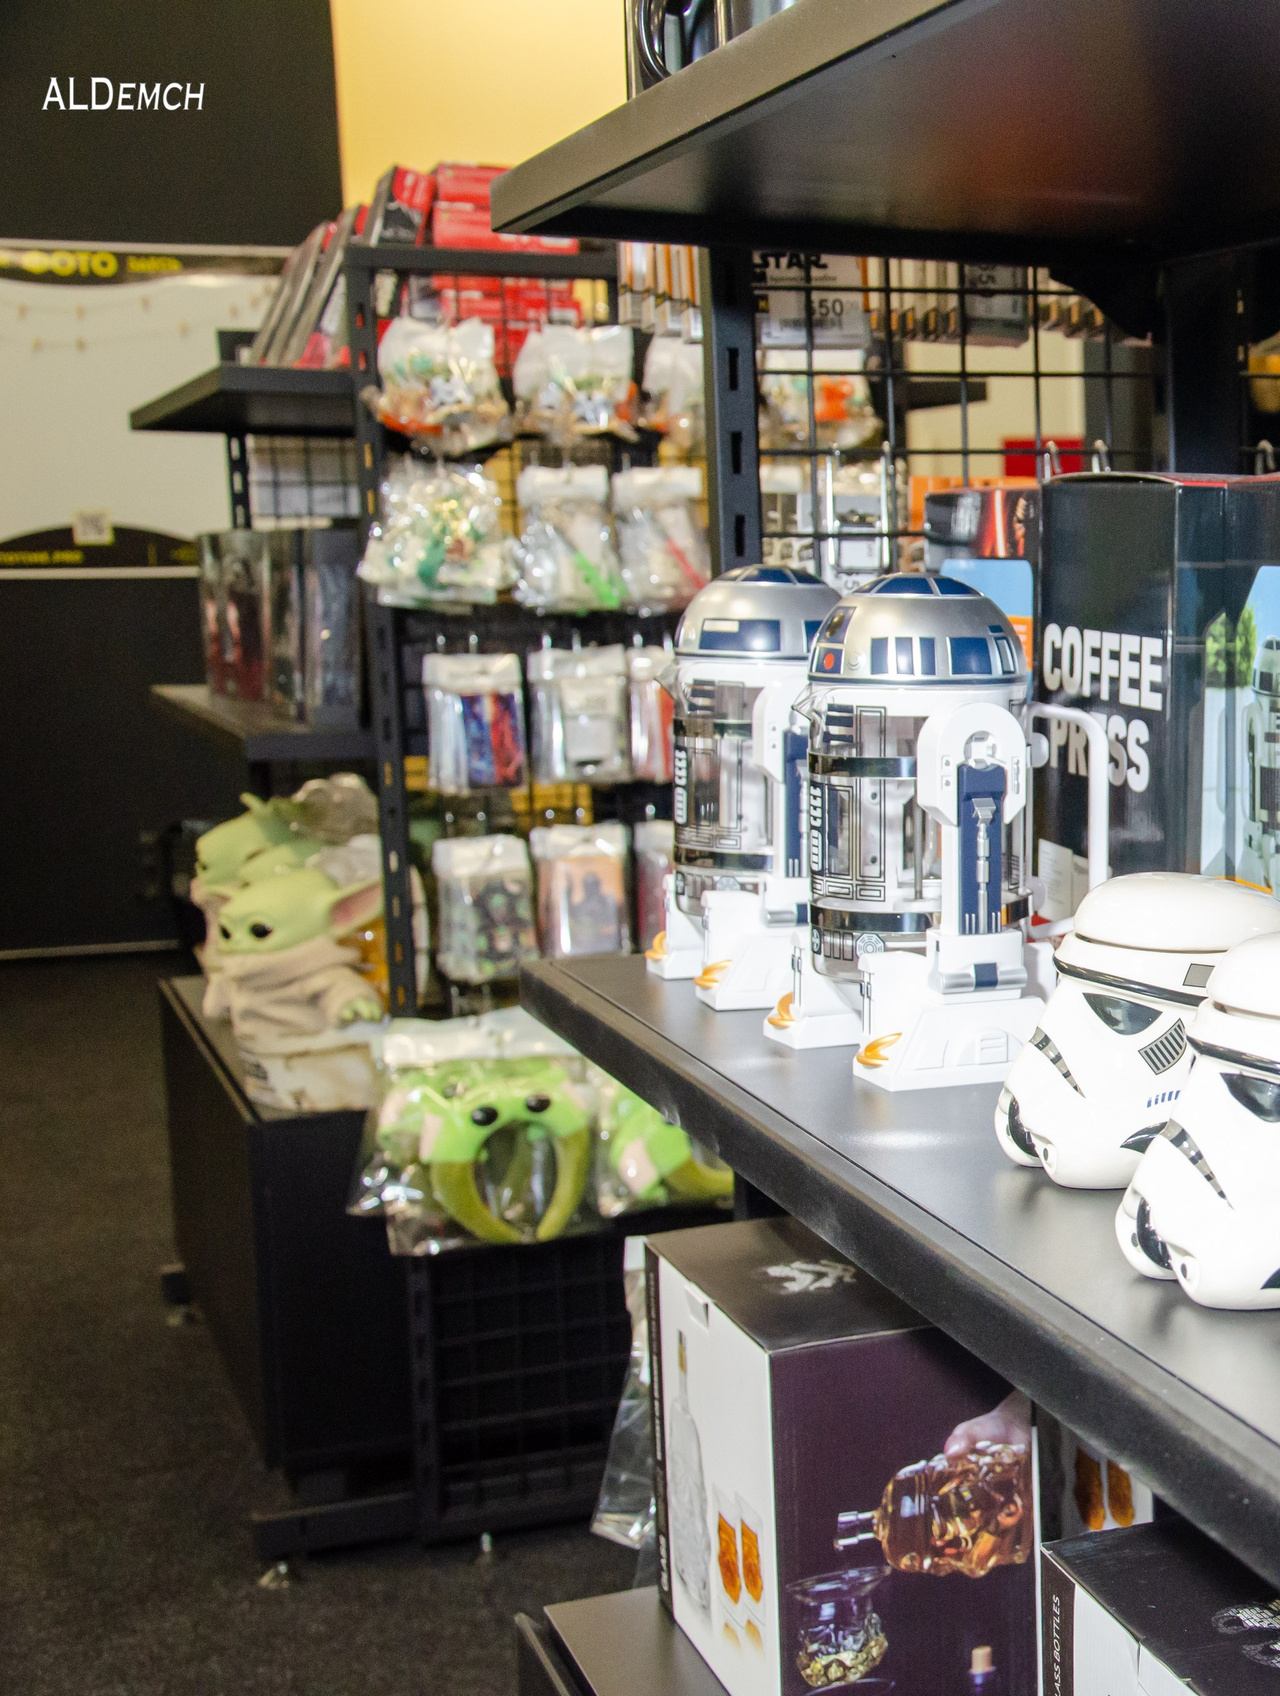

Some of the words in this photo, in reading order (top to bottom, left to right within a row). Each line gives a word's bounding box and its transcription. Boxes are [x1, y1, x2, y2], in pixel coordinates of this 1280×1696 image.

[1043, 623, 1163, 711] COFFEE
[1050, 711, 1150, 792] PRSS
[1052, 1594, 1061, 1662] BOTTLES
